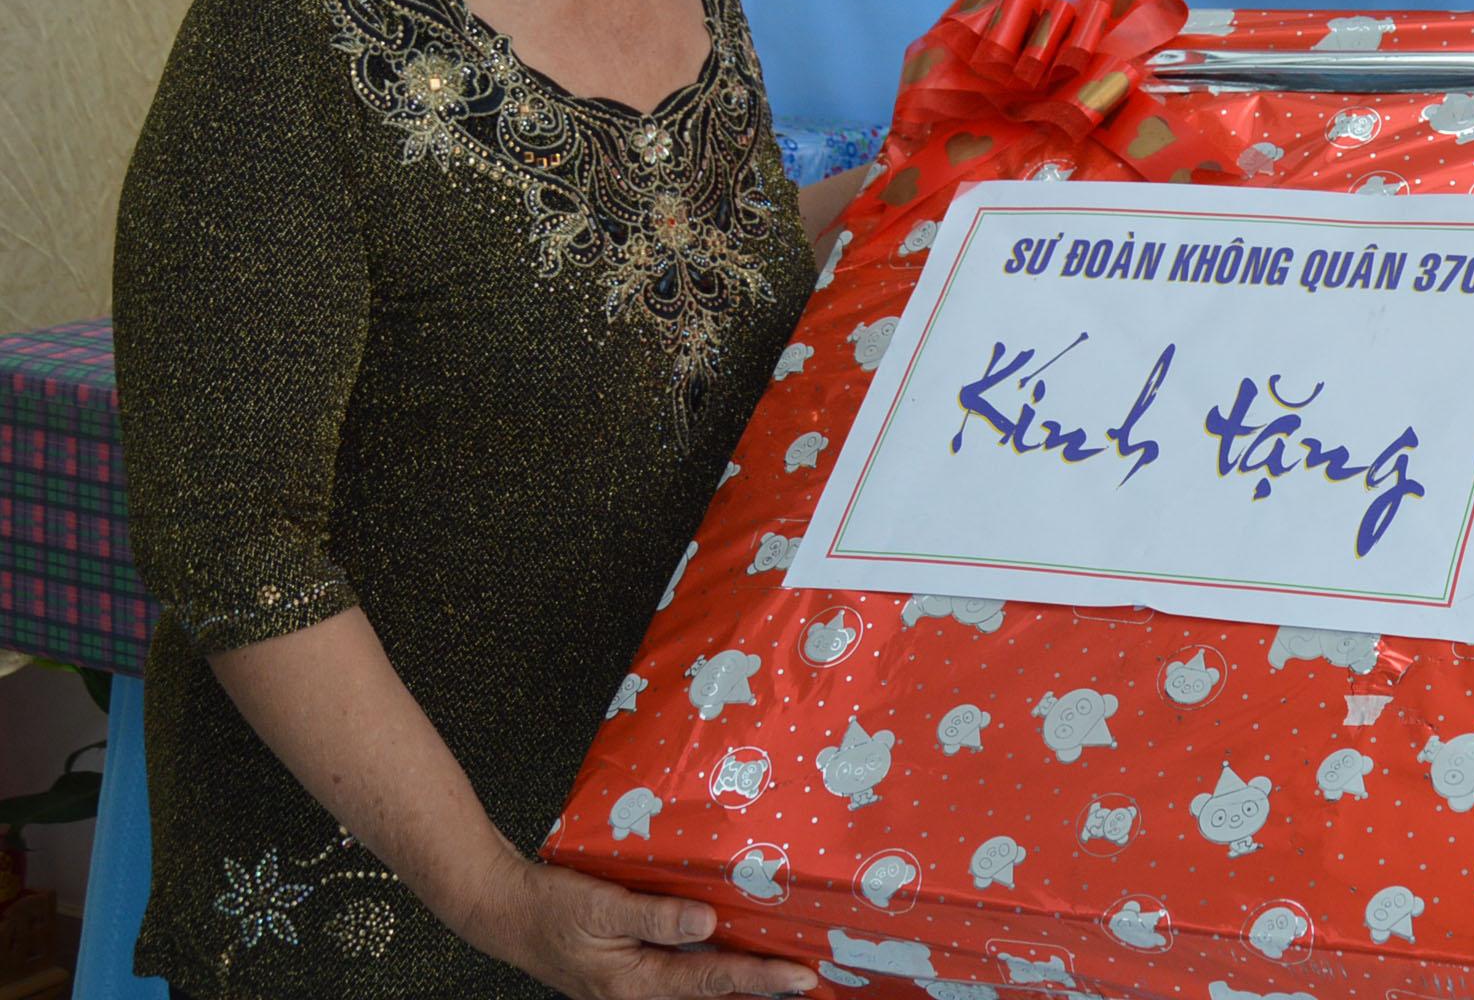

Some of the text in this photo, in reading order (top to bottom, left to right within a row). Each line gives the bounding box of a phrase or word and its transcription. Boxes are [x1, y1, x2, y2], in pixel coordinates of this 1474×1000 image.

[1004, 232, 1064, 276] SƯ
[1060, 231, 1167, 281] ĐOÀN
[1167, 237, 1294, 286] KHÔNG
[1300, 243, 1408, 293] QUÂN
[950, 331, 1426, 559] Kính tặng
